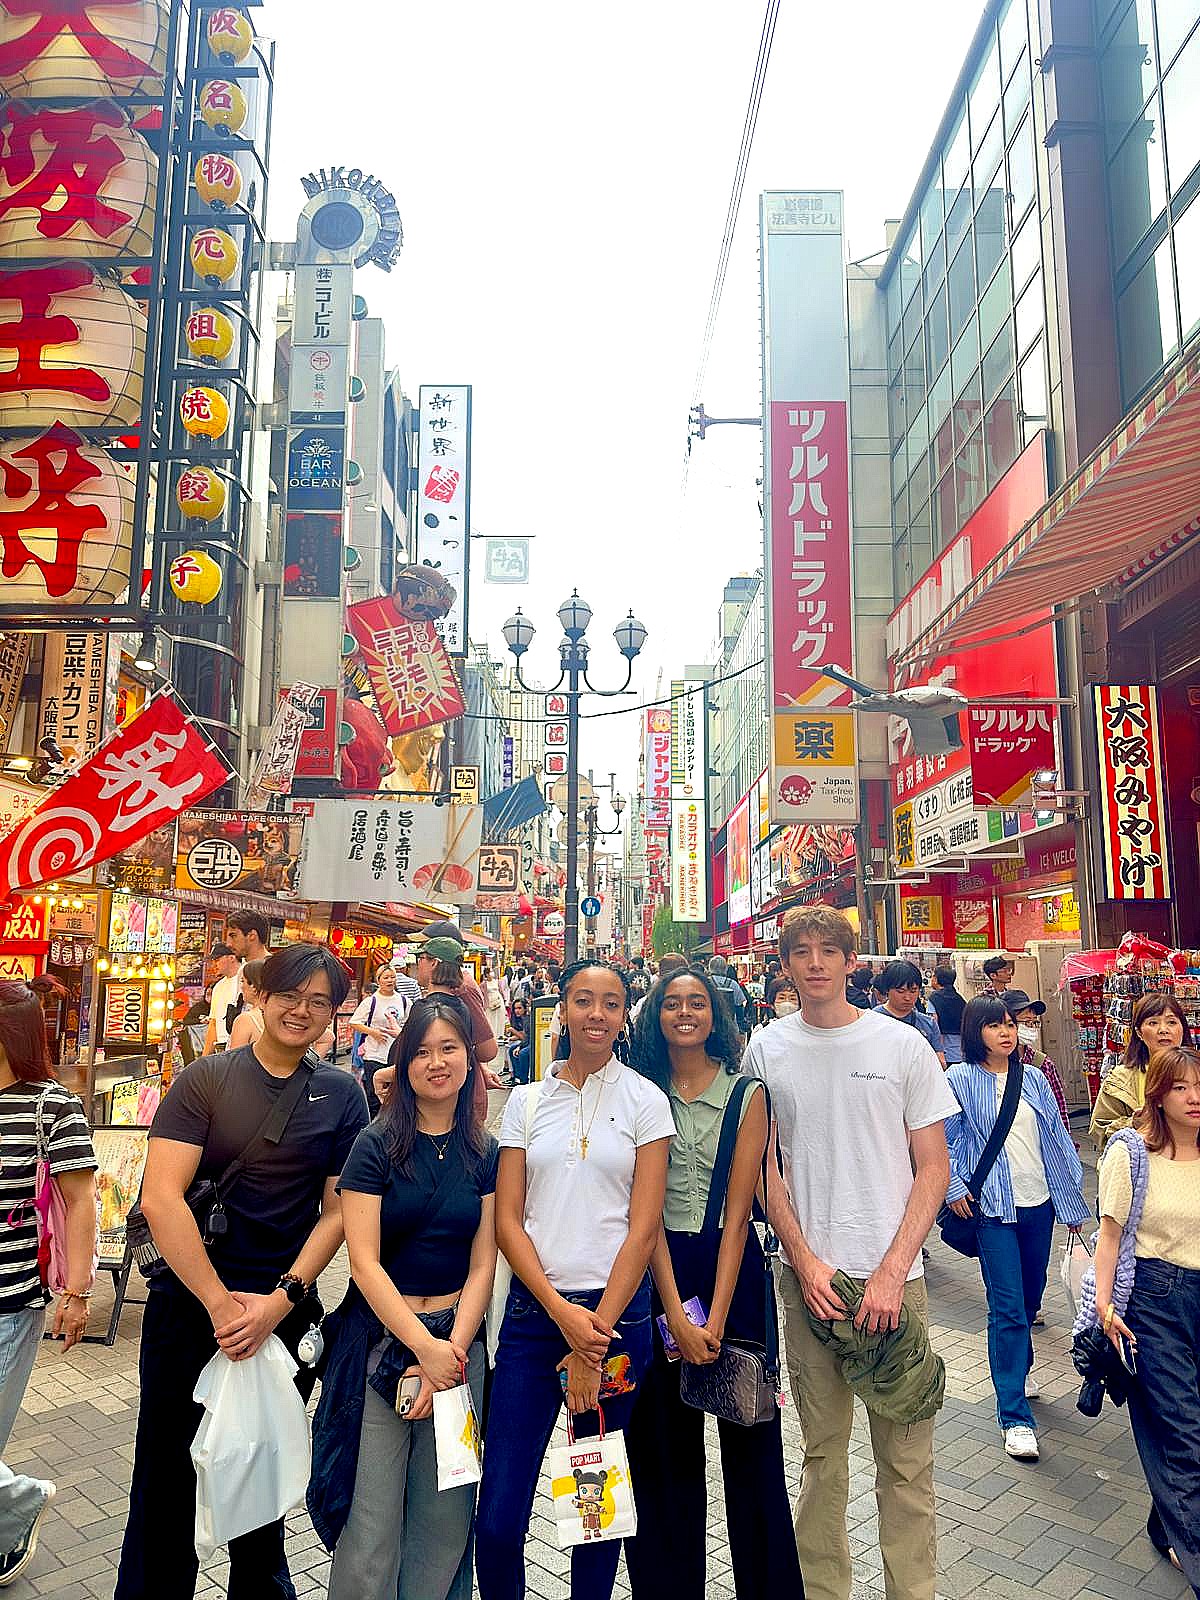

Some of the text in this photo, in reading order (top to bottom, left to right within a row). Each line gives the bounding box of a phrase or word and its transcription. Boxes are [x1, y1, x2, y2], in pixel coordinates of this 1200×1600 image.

[300, 459, 332, 470] BAR
[289, 477, 342, 488] OCEAN
[787, 409, 834, 668] ツルハドラッグ
[43, 696, 60, 738] 大阪店
[971, 708, 1052, 733] ツルハ
[794, 719, 835, 760] 薬
[973, 736, 1037, 754] ドラッグ
[821, 786, 854, 796] Tax-free
[823, 776, 853, 787] Japan.
[1104, 696, 1160, 887] 大阪みやげ
[832, 796, 854, 807] Shop
[918, 794, 938, 821] くすり
[181, 810, 304, 825] MAMESHIBA CAFE OSAKA
[896, 810, 914, 865] 薬
[481, 856, 514, 882] 牛角
[107, 987, 126, 1032] WAGYU
[571, 1452, 601, 1467] POP MART
